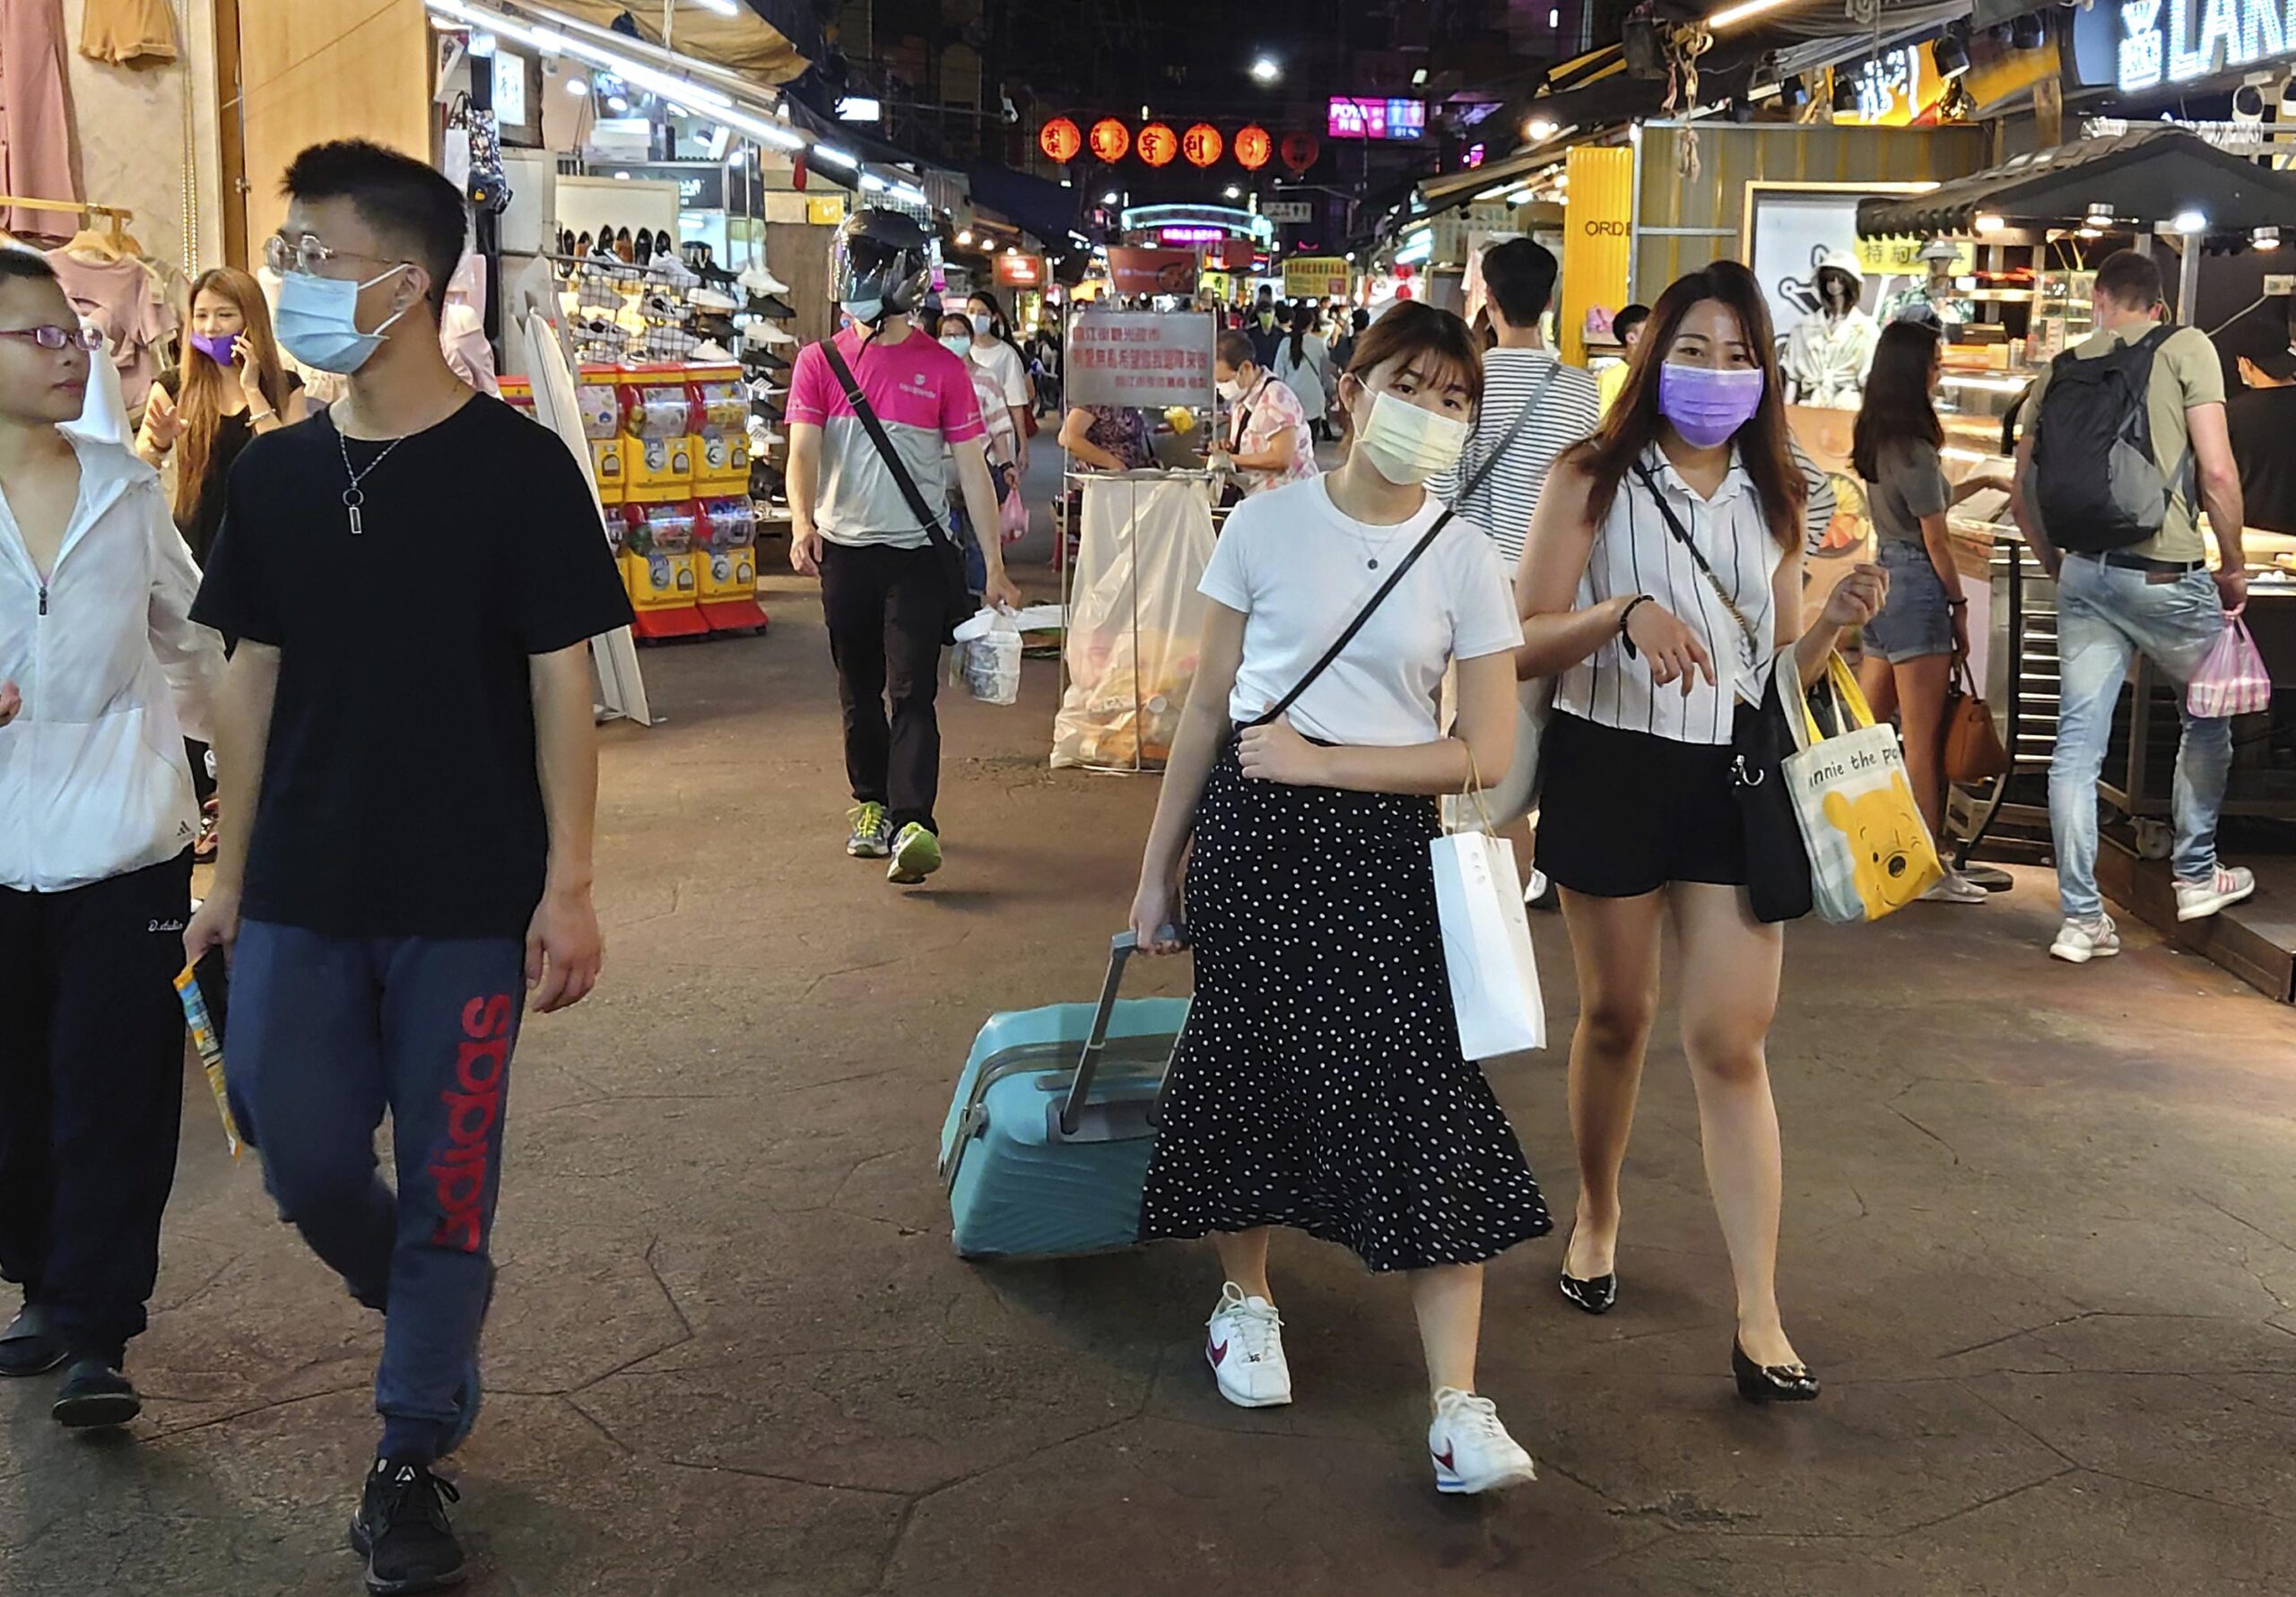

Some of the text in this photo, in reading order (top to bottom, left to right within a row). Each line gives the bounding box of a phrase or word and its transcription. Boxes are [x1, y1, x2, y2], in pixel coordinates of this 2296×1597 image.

[1185, 135, 1205, 160] 利
[1850, 750, 1876, 769] the
[426, 994, 511, 1253] adidas
